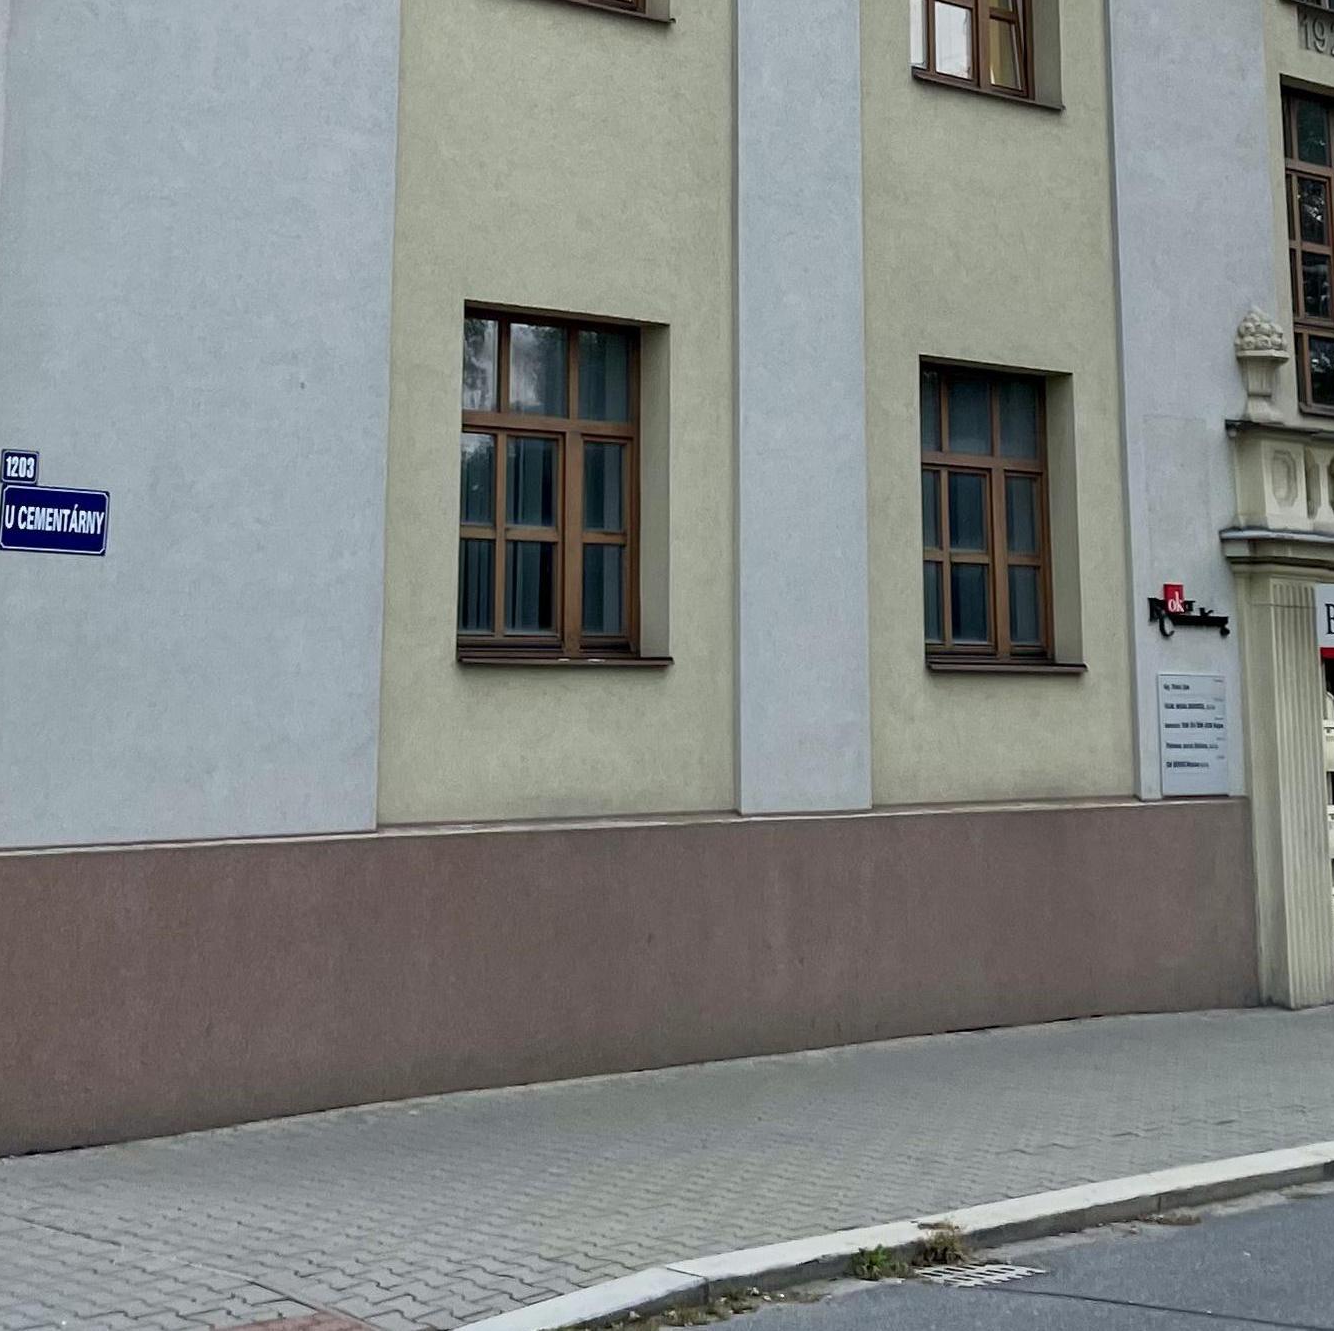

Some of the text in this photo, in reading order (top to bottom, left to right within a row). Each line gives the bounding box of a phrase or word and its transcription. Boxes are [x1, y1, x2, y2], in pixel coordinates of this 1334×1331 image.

[6, 456, 35, 478] 1203
[4, 503, 105, 535] U CEMENTÁRNY
